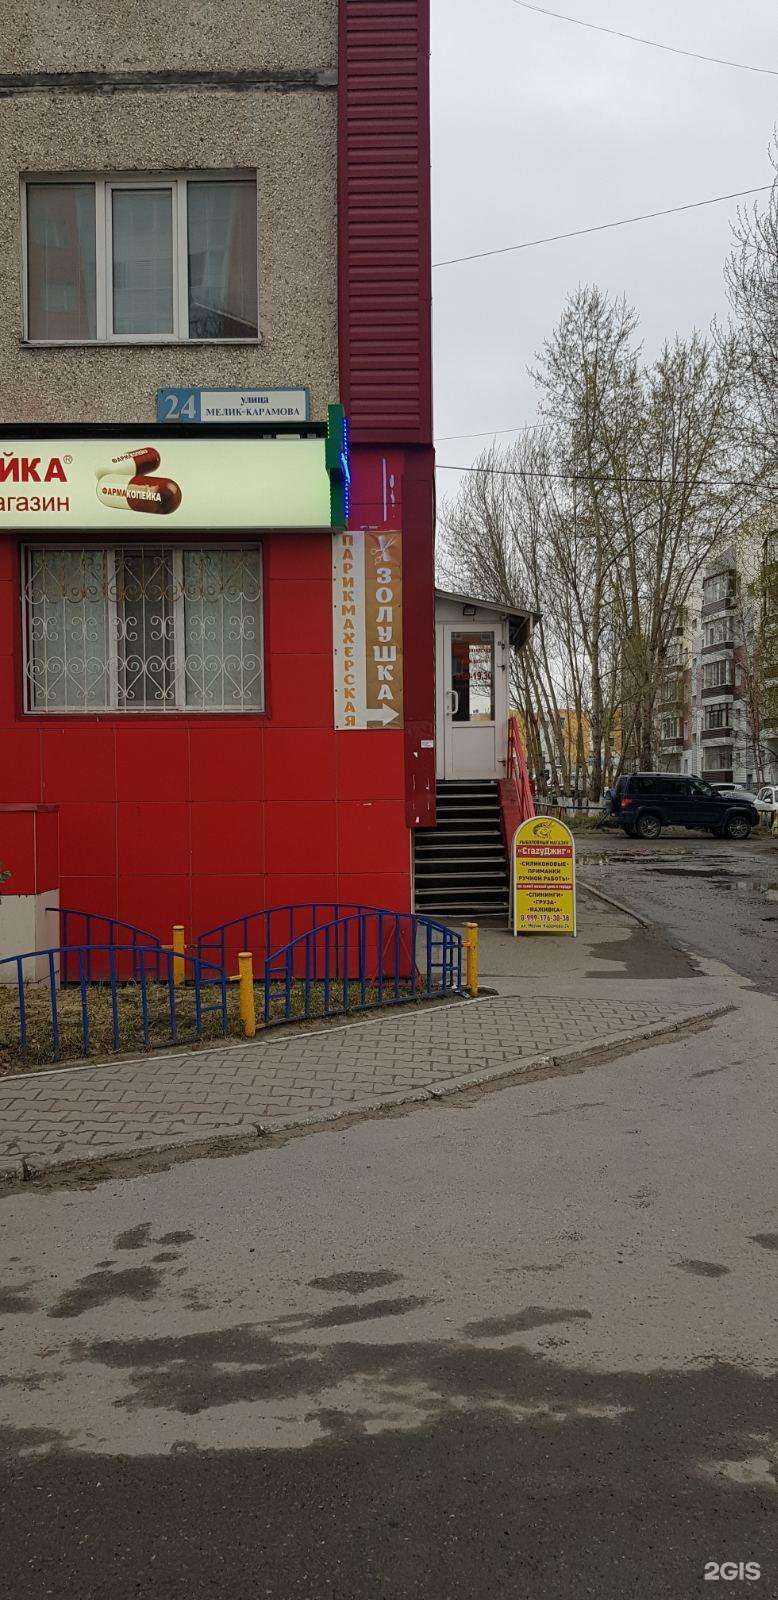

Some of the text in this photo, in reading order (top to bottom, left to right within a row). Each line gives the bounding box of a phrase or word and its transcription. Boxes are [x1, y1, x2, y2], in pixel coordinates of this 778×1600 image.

[164, 394, 197, 419] 24
[240, 396, 269, 406] улица
[205, 408, 301, 416] МЕЛИК-КАРАМОВА
[101, 486, 162, 502] ФАРМАКОПЕЙКА
[341, 534, 356, 727] ПАРИКМАХЕРСКАЯ
[373, 567, 397, 701] ЗОЛУШКА
